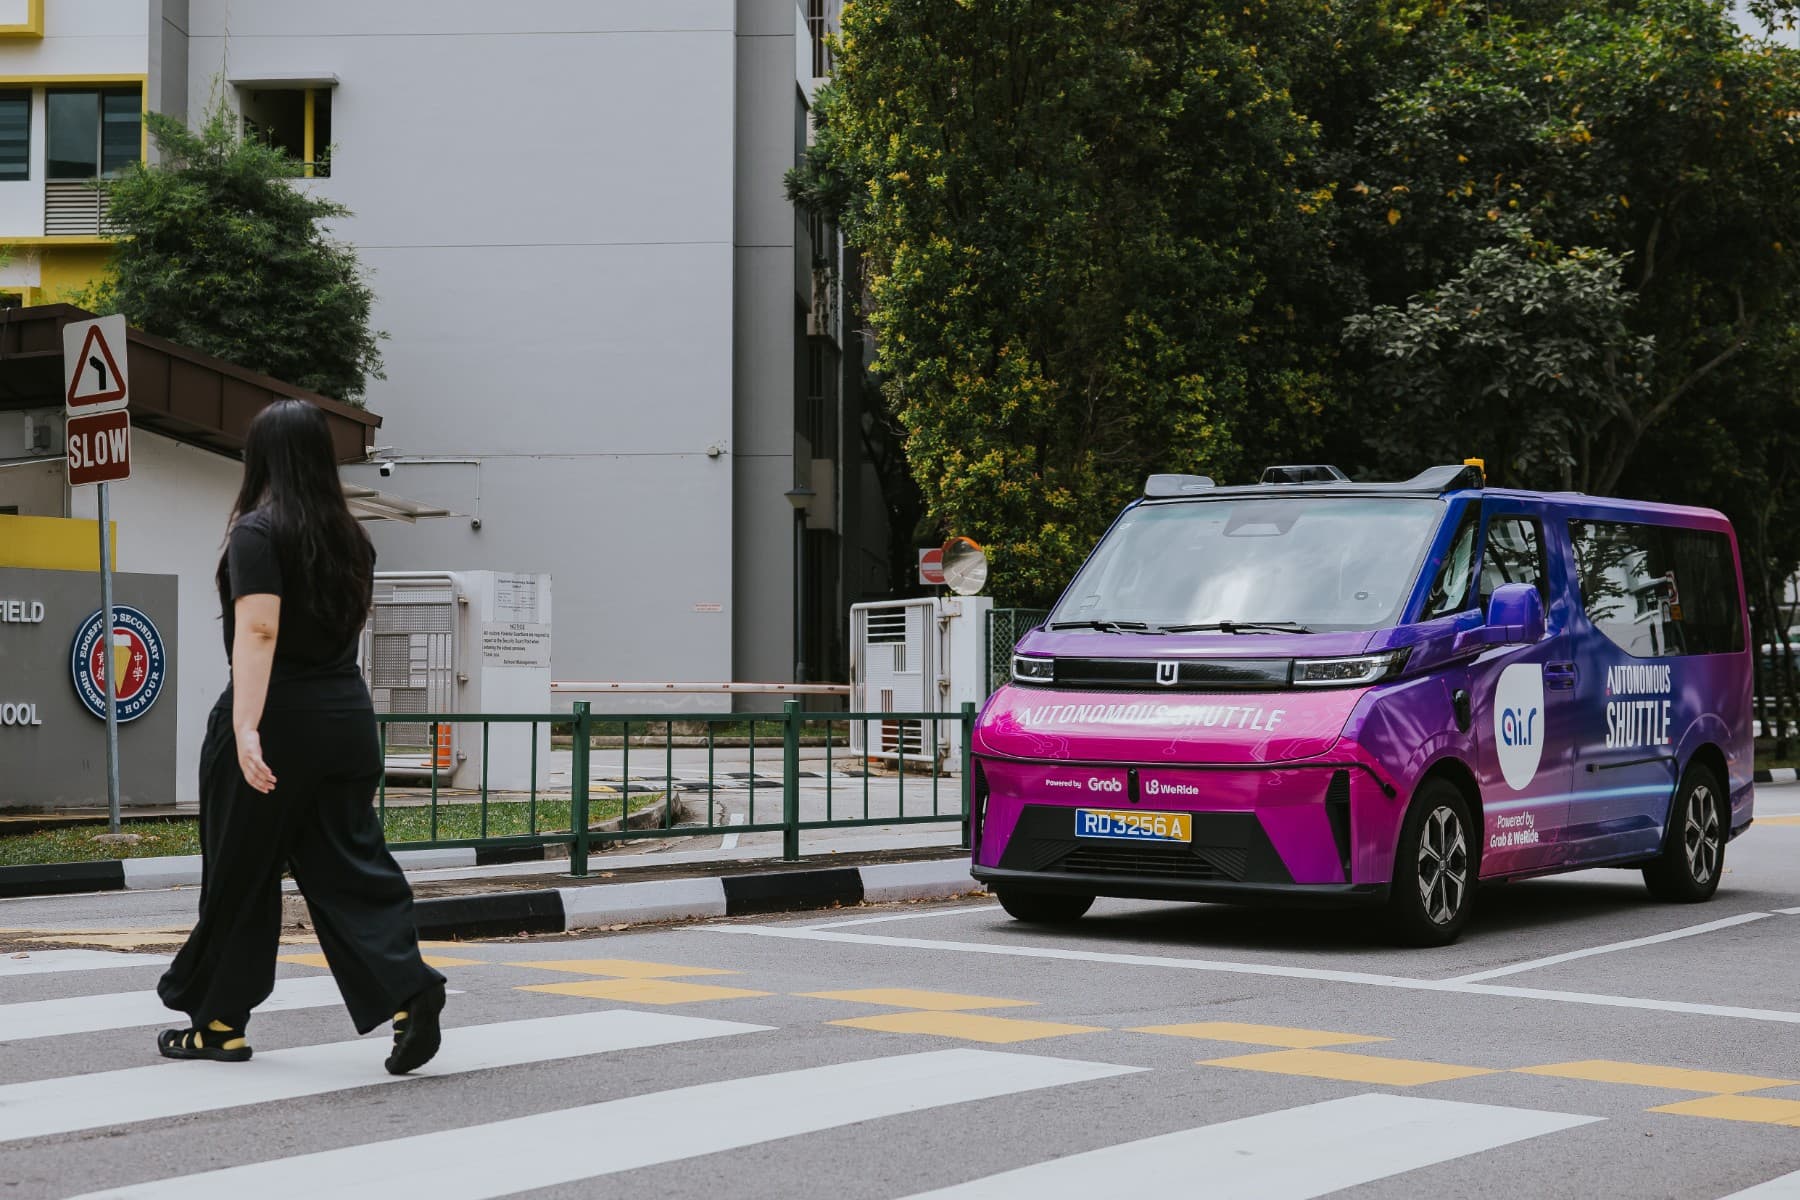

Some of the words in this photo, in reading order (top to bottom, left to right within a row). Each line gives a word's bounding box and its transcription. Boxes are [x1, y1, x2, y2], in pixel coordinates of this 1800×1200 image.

[69, 427, 127, 469] SLOW
[0, 600, 44, 622] IELD
[80, 613, 117, 659] EDGEFID
[119, 613, 160, 660] SECONDARY
[1606, 665, 1671, 695] AUTONOMOUS
[124, 671, 160, 714] HONOUR
[0, 703, 42, 725] OOL
[1016, 704, 1169, 727] AUTONOMOUS
[1169, 705, 1286, 732] SHUTTLE
[1606, 700, 1671, 748] SHUTTLE
[1045, 779, 1072, 788] Powered
[1072, 780, 1082, 789] by
[1087, 777, 1122, 792] Grab
[1160, 784, 1199, 795] WeRide
[1085, 813, 1111, 833] RD
[1113, 816, 1167, 836] 3256
[1170, 819, 1183, 837] A
[1497, 811, 1525, 828] Powered
[1525, 811, 1535, 829] by
[1490, 832, 1507, 848] Grab
[1507, 831, 1513, 846] &
[1513, 829, 1539, 845] WeRide
